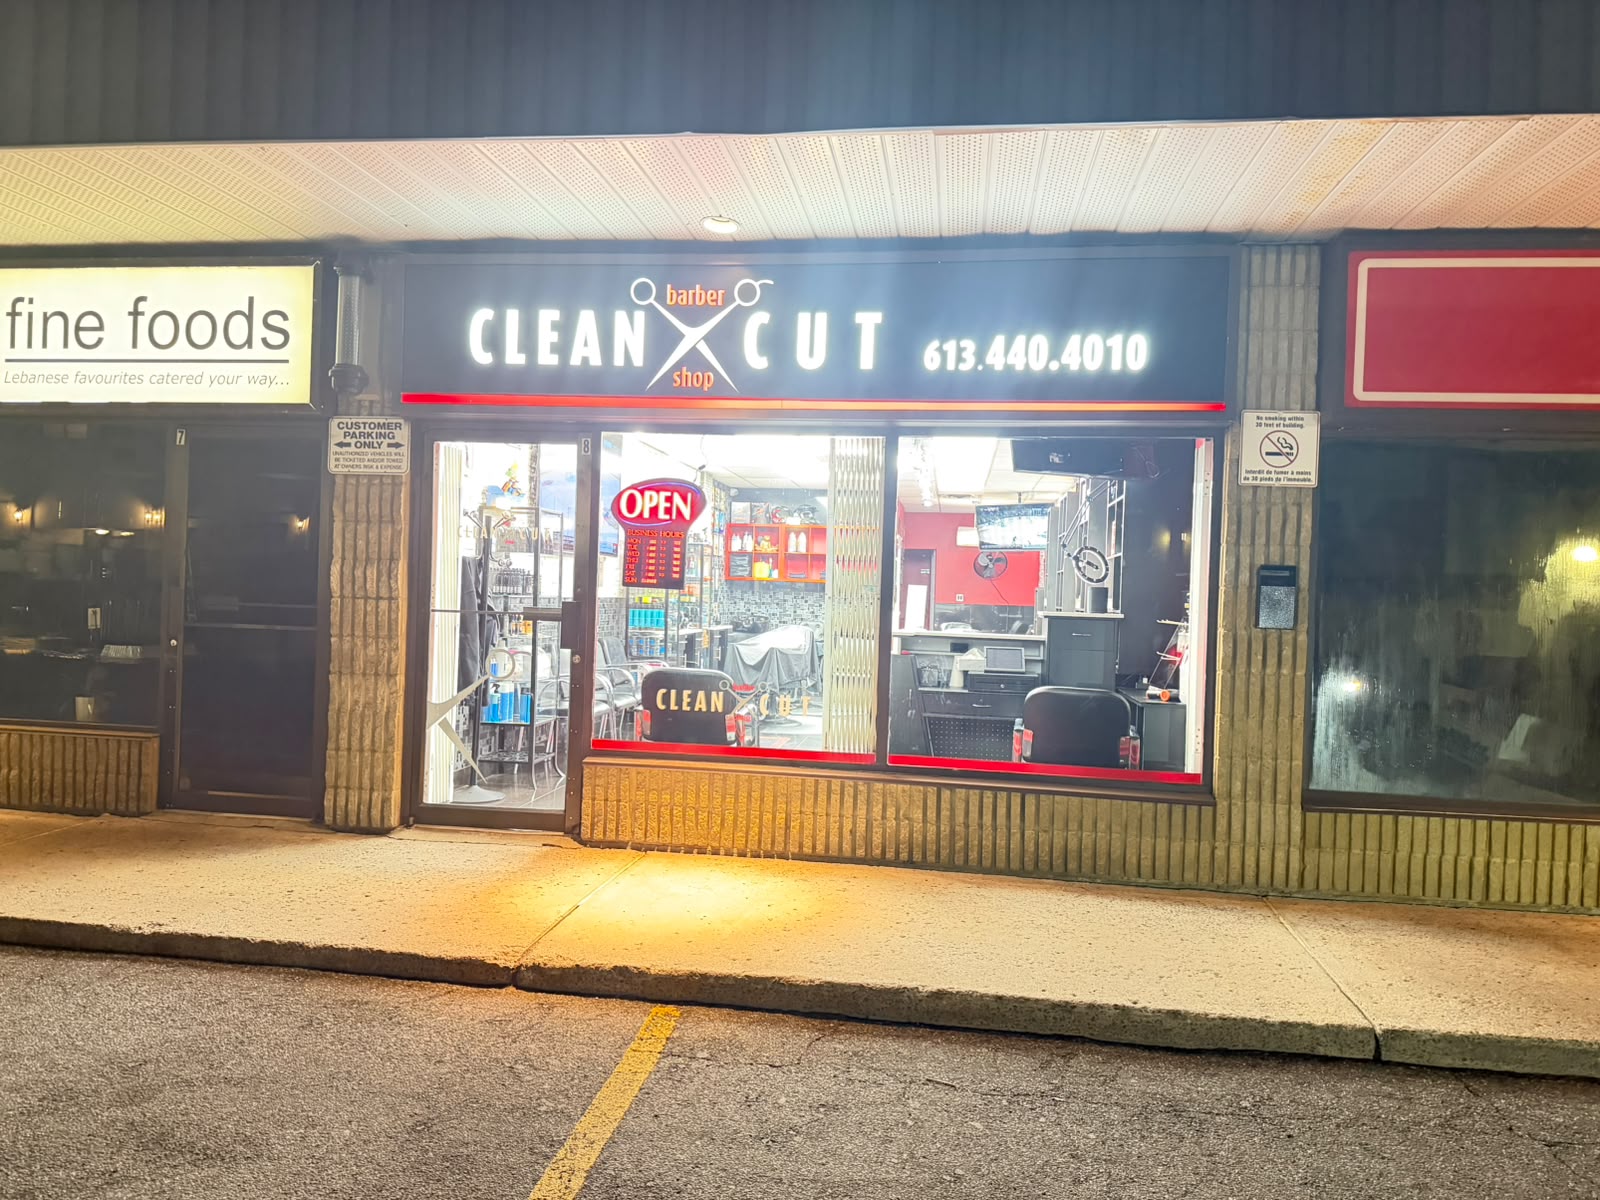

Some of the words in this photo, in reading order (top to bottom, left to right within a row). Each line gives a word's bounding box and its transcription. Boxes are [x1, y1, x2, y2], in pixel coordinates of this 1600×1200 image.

[666, 283, 725, 307] barber
[5, 296, 105, 350] fine
[127, 296, 291, 351] foods
[469, 307, 646, 367] CLEAN
[743, 311, 883, 371] CUT
[923, 333, 1148, 372] 613.440.4010
[4, 371, 69, 384] Lebanese
[74, 371, 144, 385] favourites
[149, 371, 204, 385] catered
[209, 374, 242, 388] your
[247, 374, 289, 388] way...
[673, 366, 714, 392] shop
[337, 421, 402, 431] CUSTOMER
[343, 431, 395, 440] PARKING
[178, 430, 184, 444] 7
[354, 440, 383, 449] ONLY
[583, 439, 590, 454] 8
[620, 489, 691, 520] OPEN
[660, 531, 685, 539] HOURS
[656, 688, 724, 713] CLEAN
[759, 693, 811, 718] CUT
